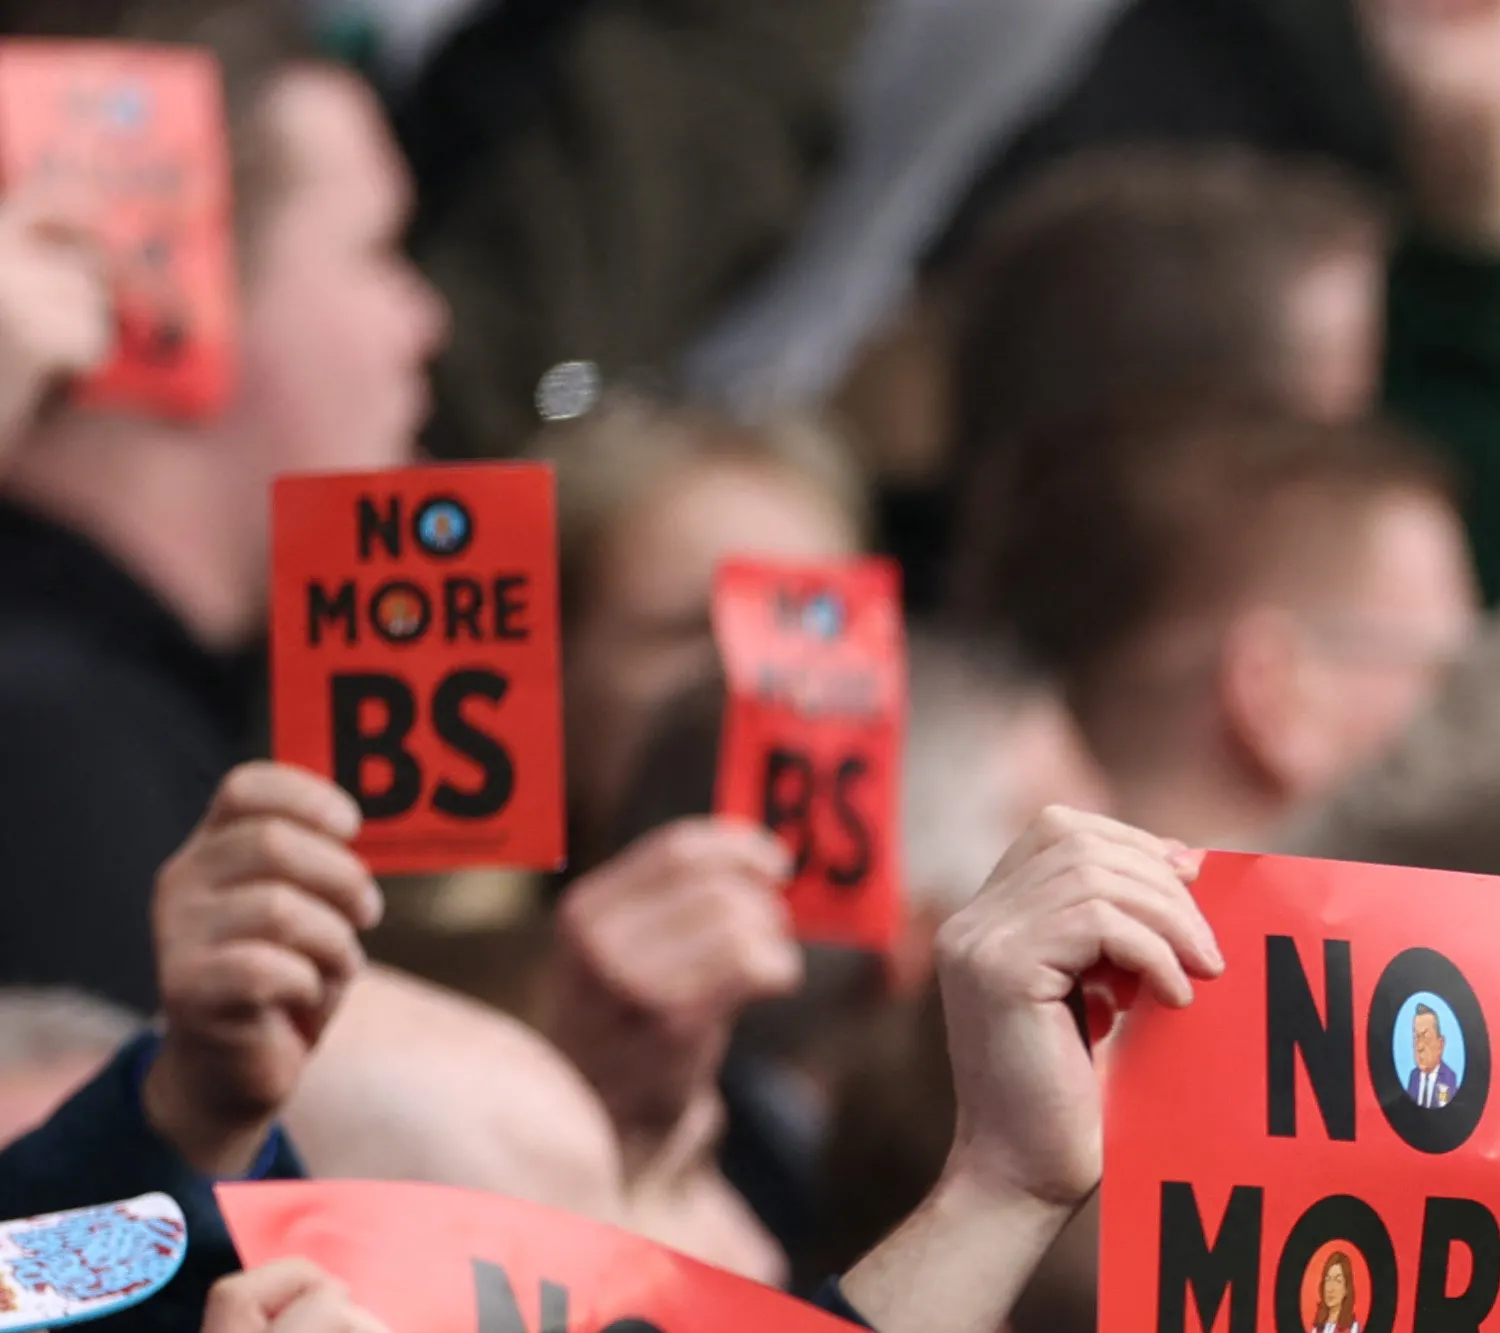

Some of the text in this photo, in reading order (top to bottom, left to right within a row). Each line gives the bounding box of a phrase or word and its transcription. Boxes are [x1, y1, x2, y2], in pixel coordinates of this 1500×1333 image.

[356, 494, 473, 561] NO
[306, 575, 530, 645] MORE
[329, 669, 514, 820] BS
[762, 747, 874, 888] BS
[1265, 935, 1491, 1153] NO
